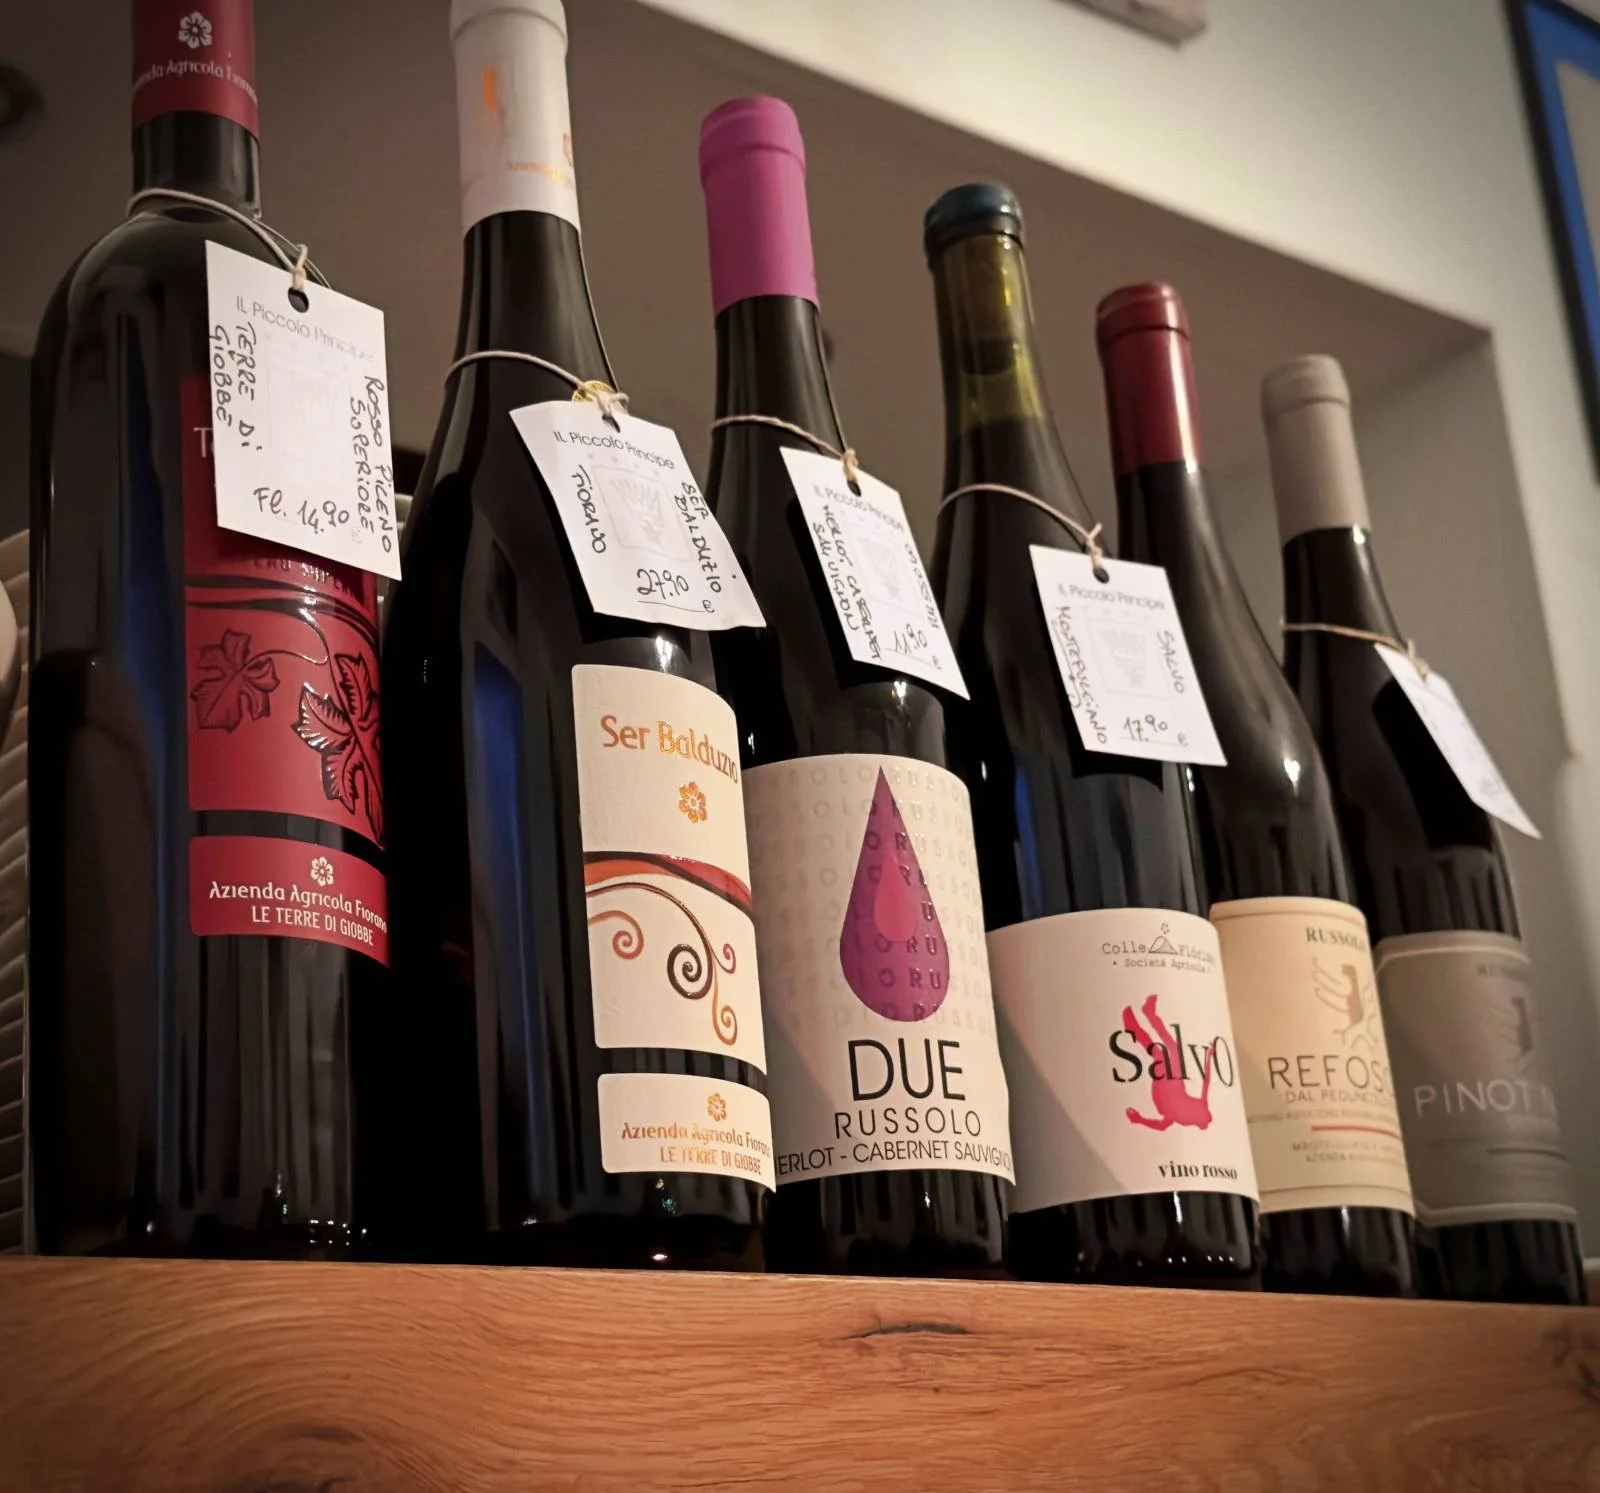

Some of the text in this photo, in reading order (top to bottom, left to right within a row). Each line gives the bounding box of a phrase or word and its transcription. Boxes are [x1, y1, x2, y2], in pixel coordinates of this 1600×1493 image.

[252, 301, 311, 338] Piccolo
[209, 325, 234, 428] GIOBBE
[235, 321, 257, 402] TERRE
[363, 375, 385, 448] ROSSO
[569, 432, 624, 451] Piccolo
[625, 441, 676, 470] Principe
[681, 481, 709, 521] SER
[1156, 630, 1185, 695] SALVO
[600, 715, 739, 786] Ser Balduzio
[209, 881, 286, 901] Azienda
[290, 884, 352, 914] Agricola
[251, 906, 374, 946] LE TERRE DI GIOBBE
[1102, 941, 1146, 956] Colle
[848, 1037, 967, 1102] DUE
[1285, 1090, 1315, 1105] DAL
[1413, 1078, 1531, 1119] PINOT
[622, 1122, 688, 1140] Azienda
[691, 1124, 743, 1146] Agricola
[834, 1107, 981, 1139] RUSSOLO
[660, 1146, 676, 1163] LE
[720, 1150, 732, 1167] DI
[734, 1153, 762, 1175] GIOBBE
[778, 1147, 834, 1175] ERLOT
[853, 1139, 949, 1164] CABERNET
[1158, 1160, 1238, 1180] vino rosso
